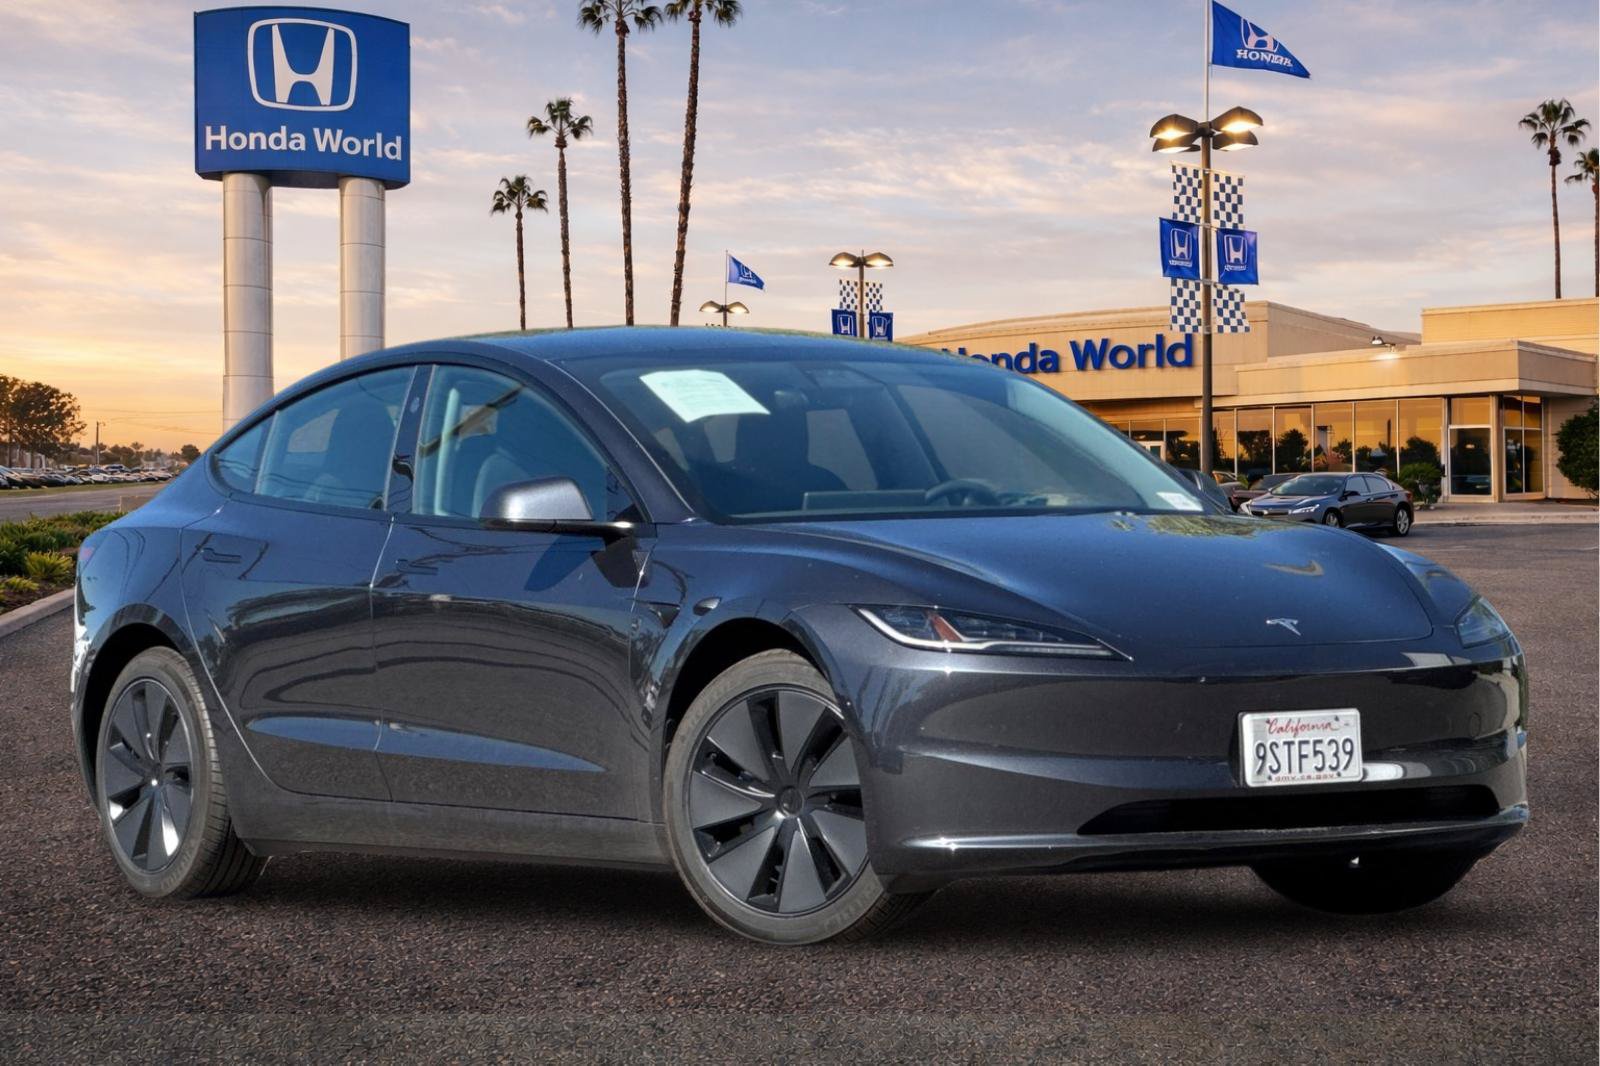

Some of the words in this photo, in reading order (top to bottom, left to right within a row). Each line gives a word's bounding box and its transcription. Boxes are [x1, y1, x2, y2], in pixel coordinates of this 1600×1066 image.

[205, 125, 306, 151] Honda
[313, 127, 402, 161] World
[941, 342, 1060, 374] nda
[1069, 333, 1194, 371] World
[1267, 717, 1341, 737] California
[1255, 737, 1354, 775] 9STF539
